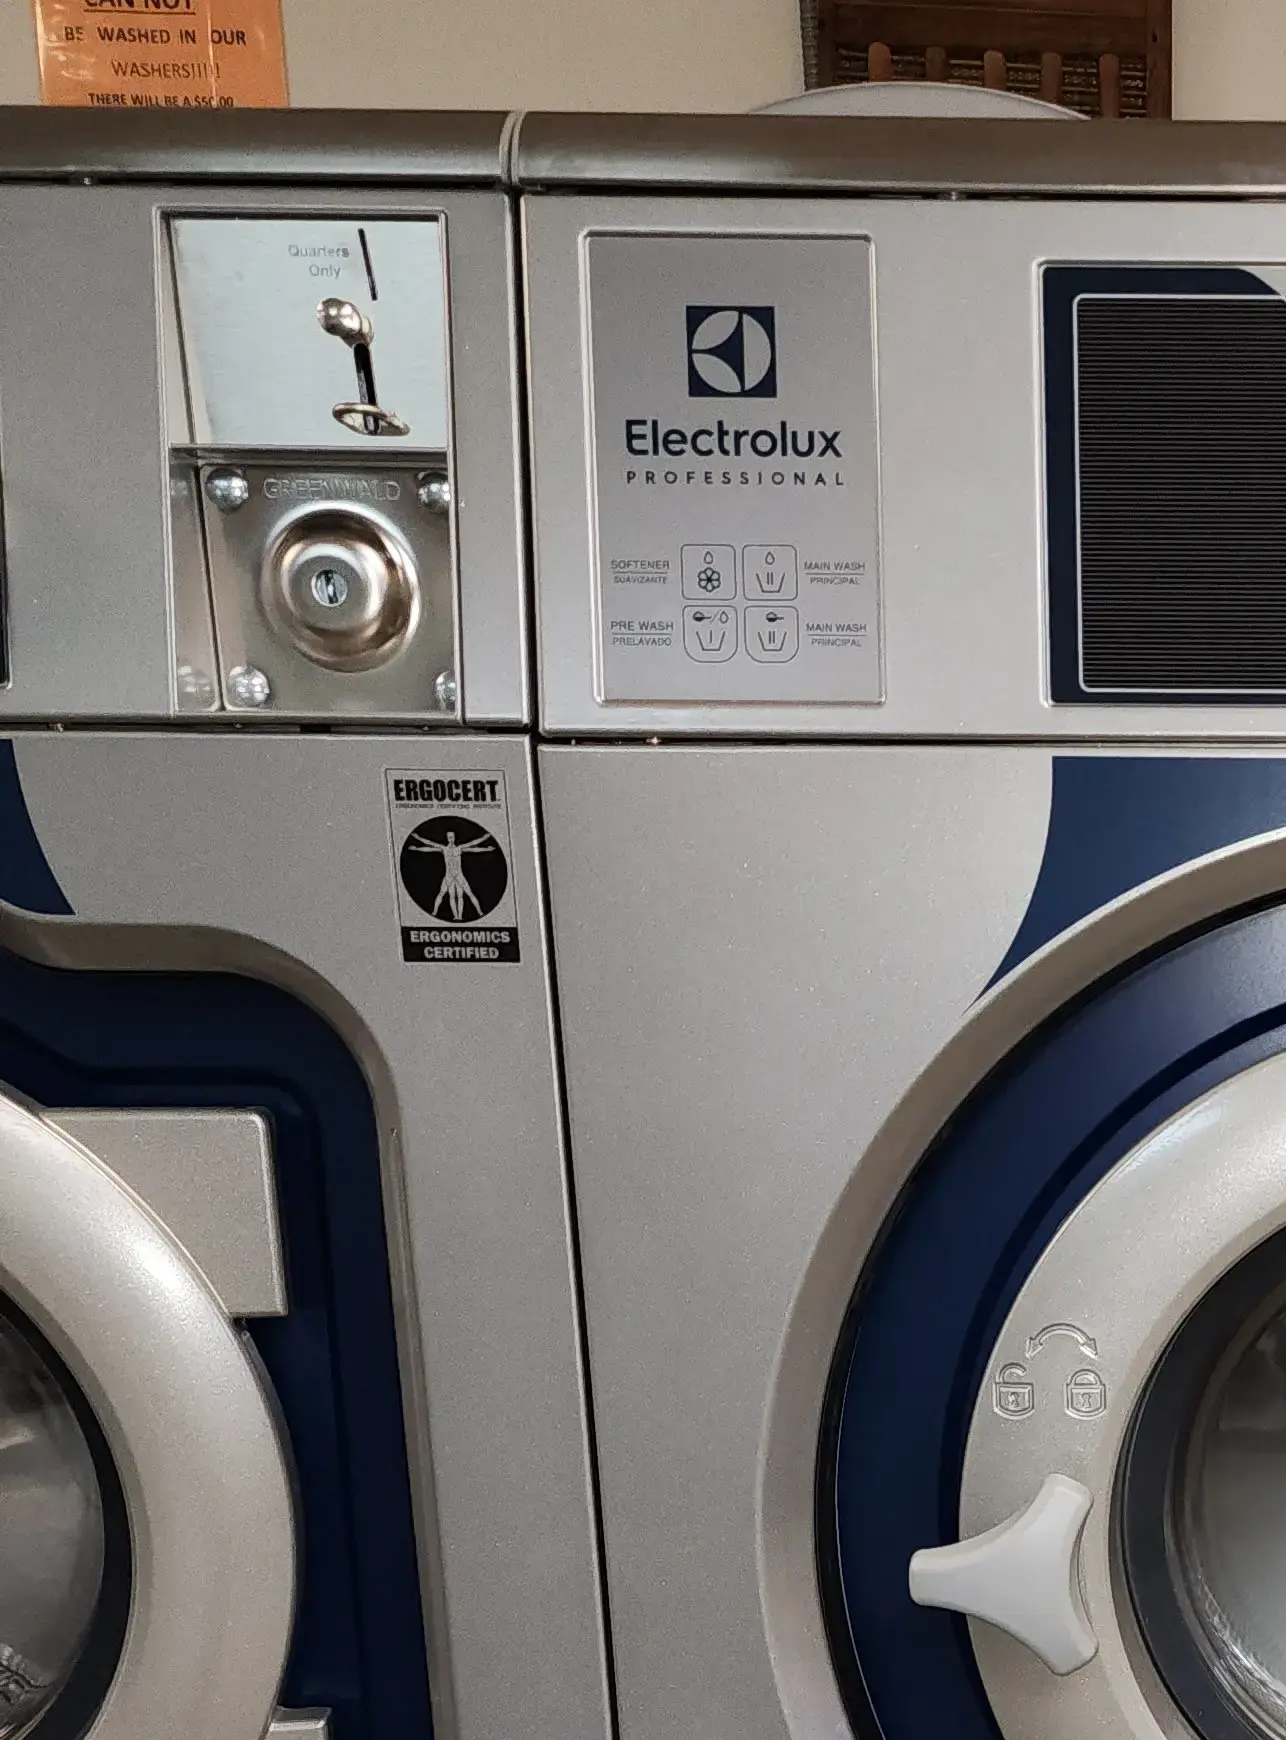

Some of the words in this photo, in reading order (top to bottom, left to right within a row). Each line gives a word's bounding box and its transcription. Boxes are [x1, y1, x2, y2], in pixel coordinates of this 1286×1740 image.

[64, 25, 84, 42] BE
[97, 26, 171, 44] WASHED
[179, 28, 197, 45] IN
[210, 29, 247, 46] OUR
[88, 92, 127, 106] THERE
[130, 93, 161, 108] WILL
[163, 95, 180, 107] BE
[288, 244, 350, 259] Quarters
[308, 263, 342, 280] Only
[625, 419, 843, 458] Electrolux
[626, 470, 845, 486] PROFESSIONAL
[263, 477, 402, 501] GREENWALD
[610, 559, 670, 570] SOFTENER
[803, 561, 831, 571] MAIN
[834, 561, 866, 571] WASH
[610, 620, 635, 632] PRE
[638, 620, 674, 632] WASH
[805, 622, 833, 633] MAIN
[835, 623, 867, 633] WASH
[612, 636, 673, 647] PRELAVADO
[393, 778, 499, 803] ERGOCERT
[409, 930, 511, 944] ERGONOMICS
[423, 946, 500, 960] CERTIFIED
